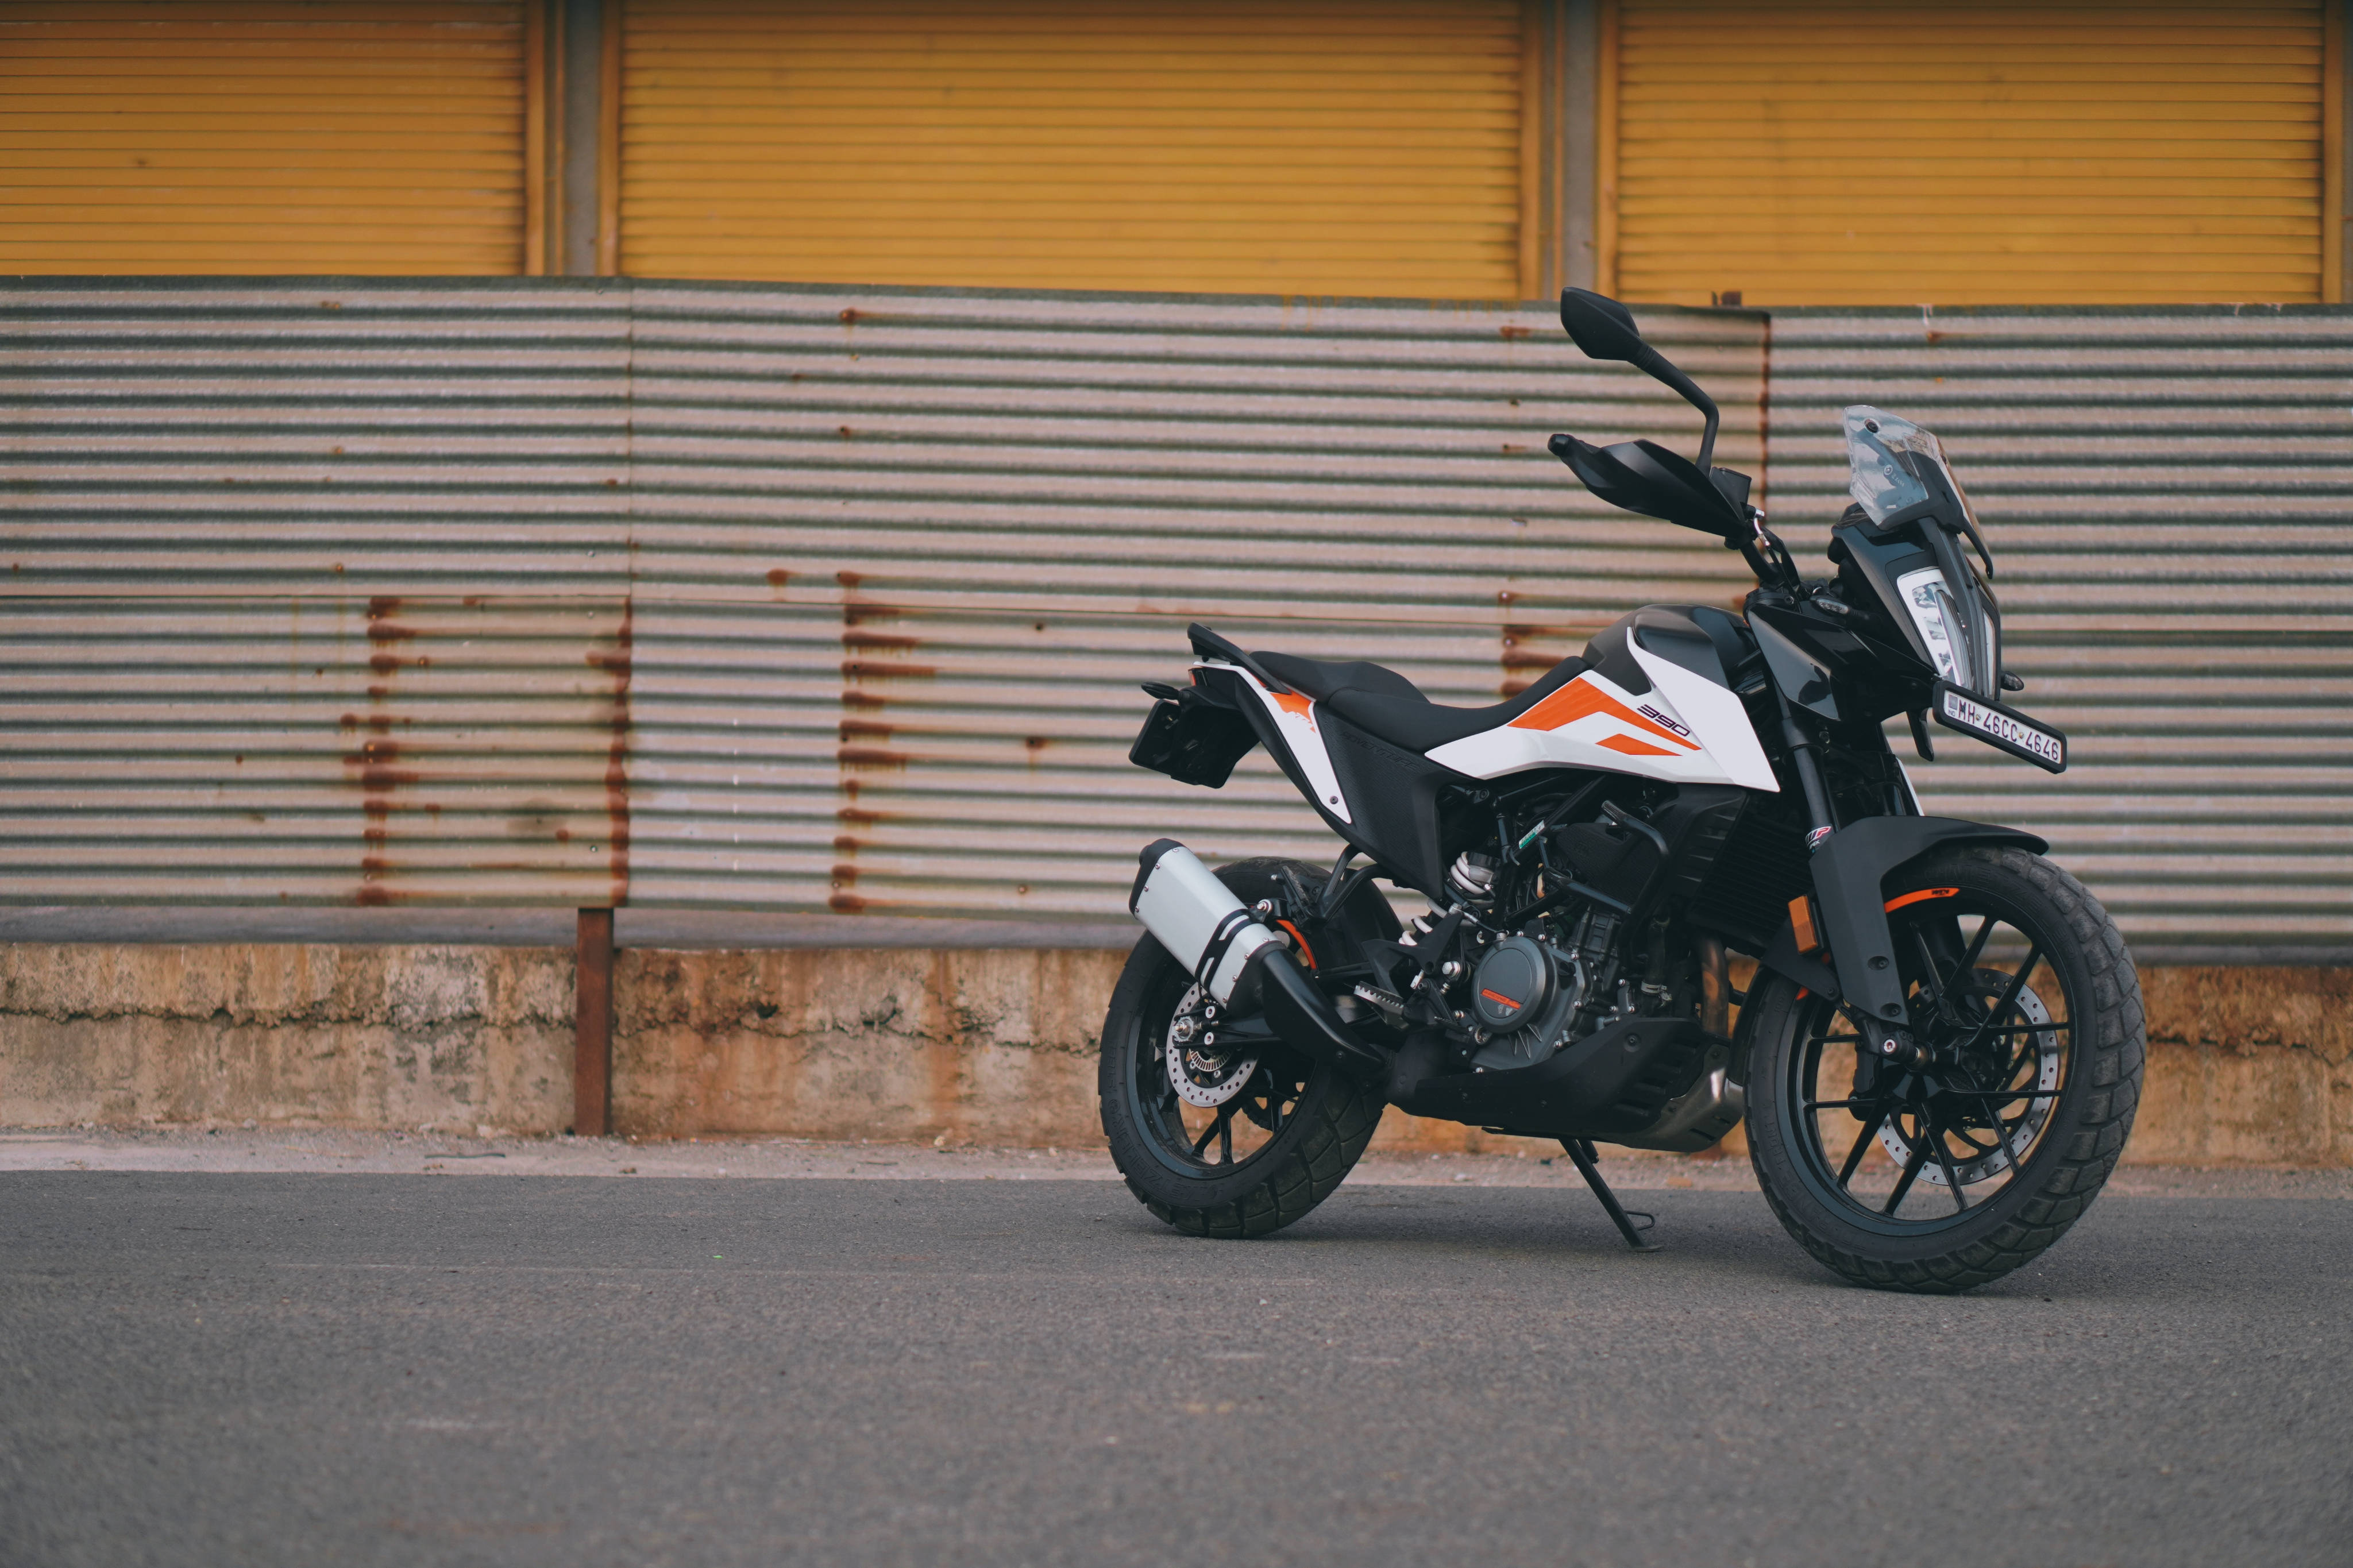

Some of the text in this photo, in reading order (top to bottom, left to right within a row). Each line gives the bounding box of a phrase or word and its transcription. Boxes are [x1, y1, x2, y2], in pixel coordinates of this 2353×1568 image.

[1637, 704, 1690, 736] 390
[1947, 708, 1955, 717] IND
[1958, 699, 2058, 760] MH 46CC 4646
